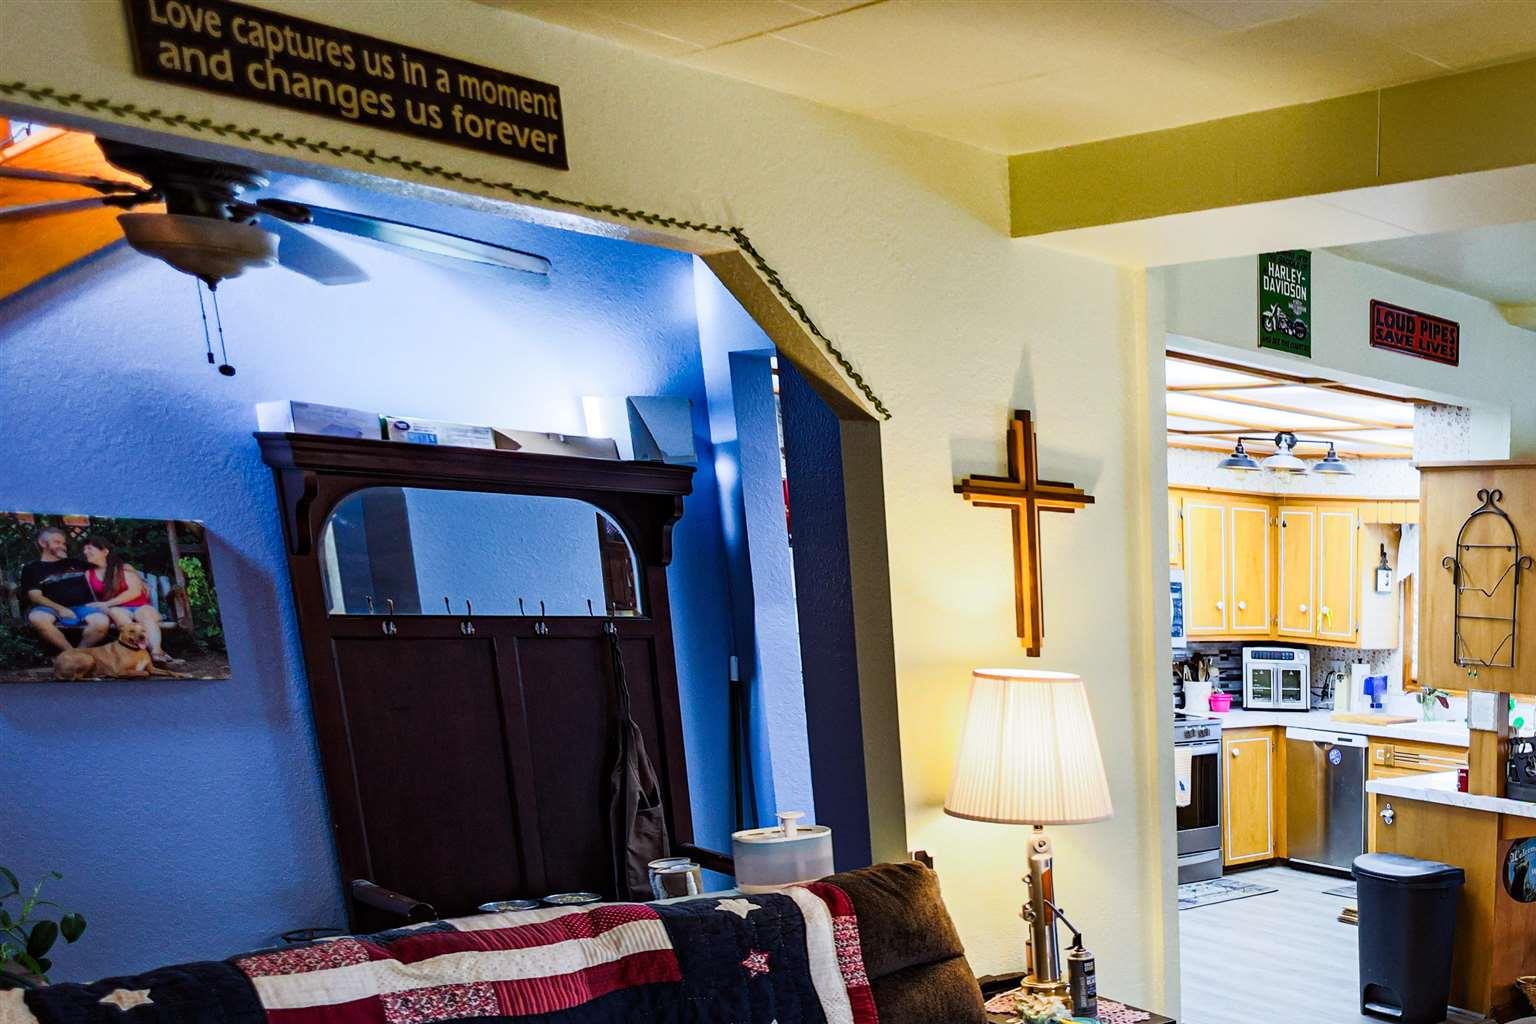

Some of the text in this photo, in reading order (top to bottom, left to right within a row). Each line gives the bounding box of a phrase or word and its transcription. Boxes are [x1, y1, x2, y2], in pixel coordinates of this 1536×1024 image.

[149, 0, 558, 121] Love captures us in a moment
[159, 41, 557, 155] and changes us forever
[1263, 275, 1307, 300] DAVIDSON
[1268, 262, 1306, 285] HARLEY-
[1375, 307, 1456, 347] LOUD PIPES
[1375, 328, 1456, 358] SAVE LIVES
